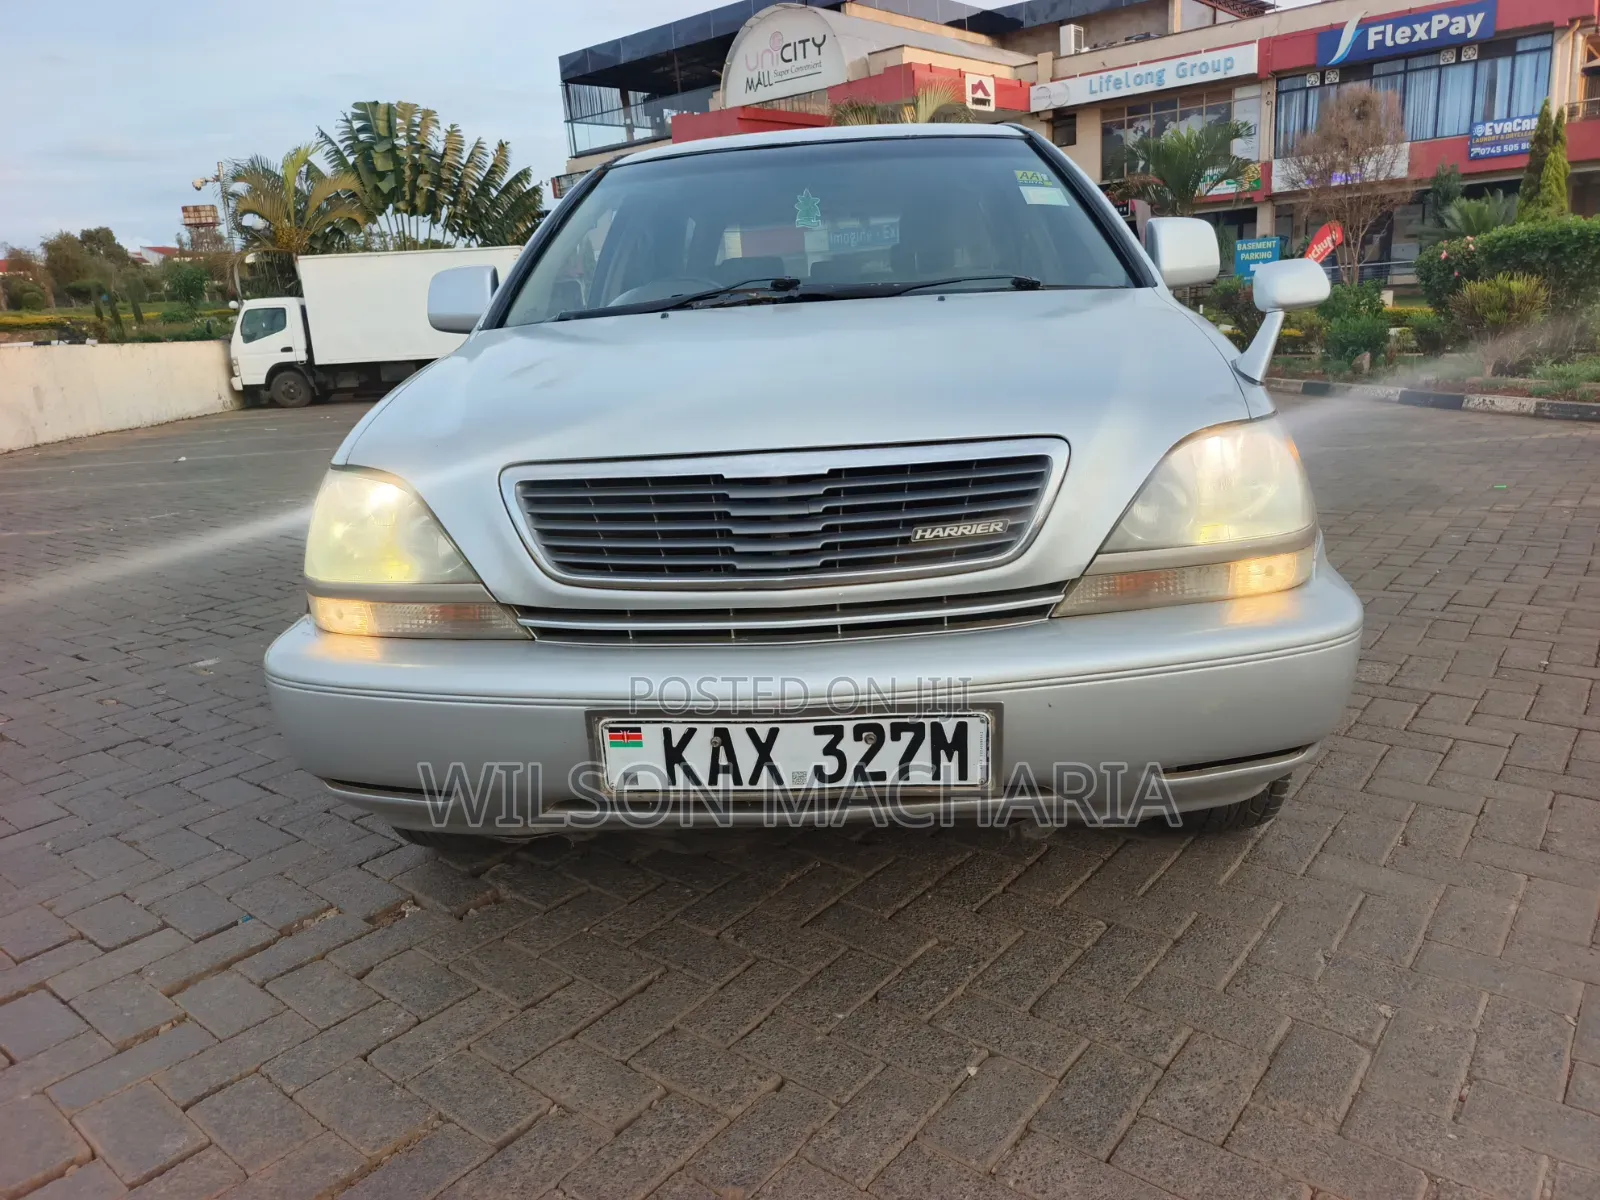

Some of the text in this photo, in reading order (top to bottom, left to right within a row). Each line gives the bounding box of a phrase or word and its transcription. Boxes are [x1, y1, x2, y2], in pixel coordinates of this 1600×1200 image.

[1367, 12, 1485, 50] FlexPay
[773, 60, 823, 78] Super Convenient
[1089, 56, 1235, 94] Lifelong Group
[745, 70, 774, 94] MALL
[1472, 136, 1500, 144] LAUNDRY
[1480, 145, 1501, 155] 0745
[1503, 144, 1519, 152] 505
[1236, 240, 1277, 251] BASEMENT
[1240, 251, 1273, 260] PARKING
[915, 521, 1004, 540] HARRIER
[662, 726, 785, 787] KAX
[813, 721, 968, 785] 327M
